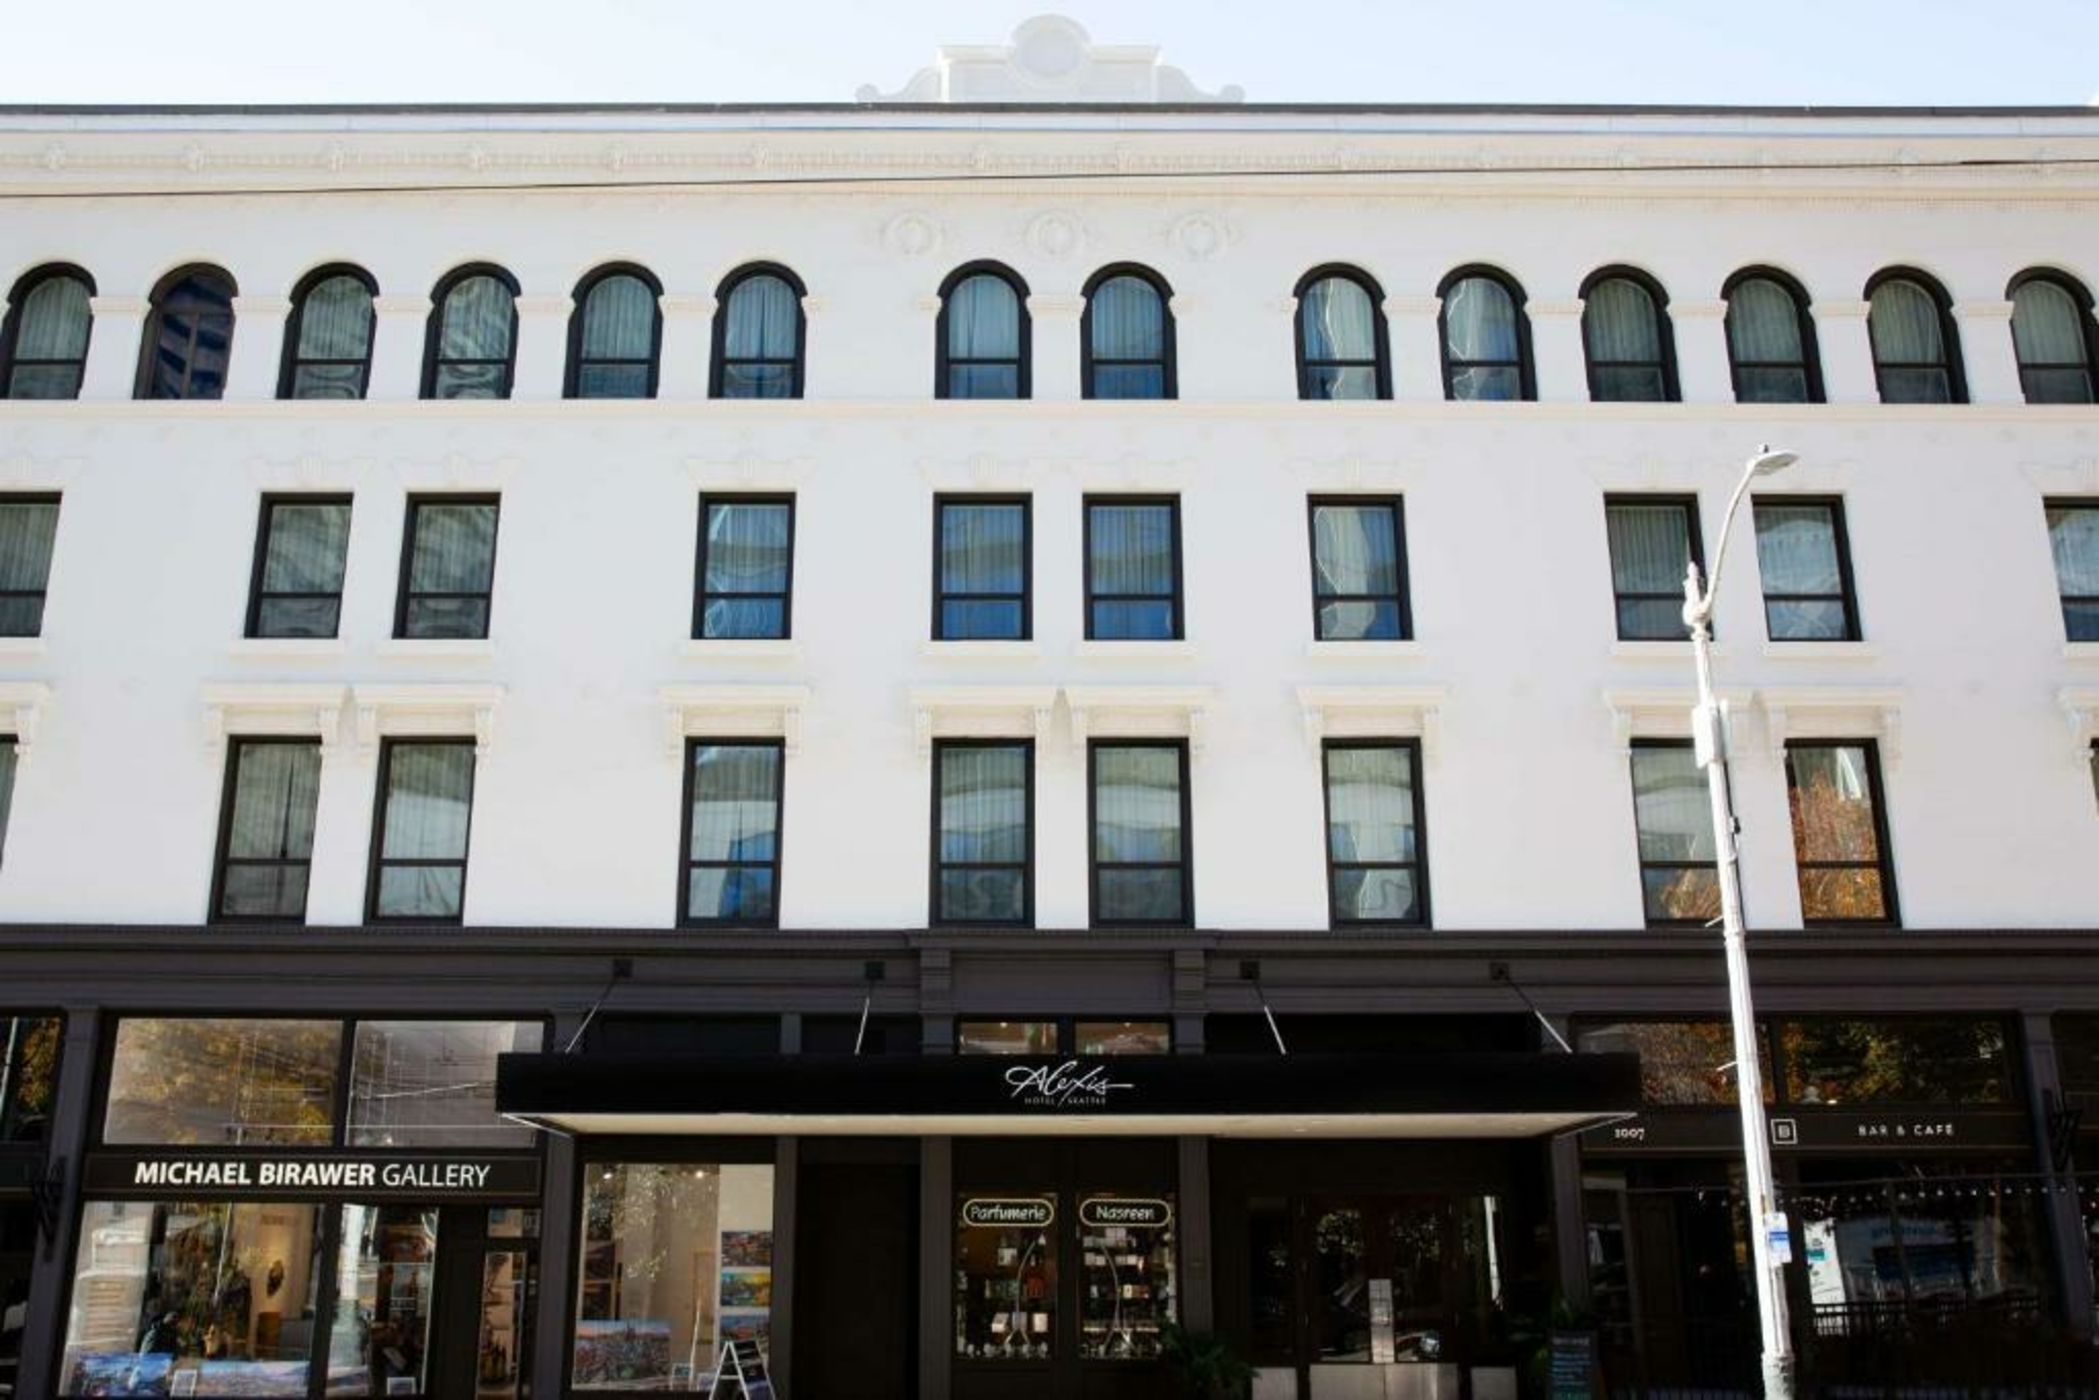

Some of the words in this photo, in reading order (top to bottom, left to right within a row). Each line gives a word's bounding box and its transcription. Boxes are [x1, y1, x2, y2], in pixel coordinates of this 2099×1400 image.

[1005, 1060, 1134, 1107] Alexis
[1614, 1128, 1645, 1140] 1007
[1858, 1125, 1887, 1136] BAR
[135, 1162, 251, 1185] MICHAEL
[259, 1163, 376, 1186] BIRAWER
[383, 1164, 490, 1187] GALLERY
[971, 1205, 1046, 1220] Parfumerie
[1096, 1206, 1154, 1220] Nasreen
